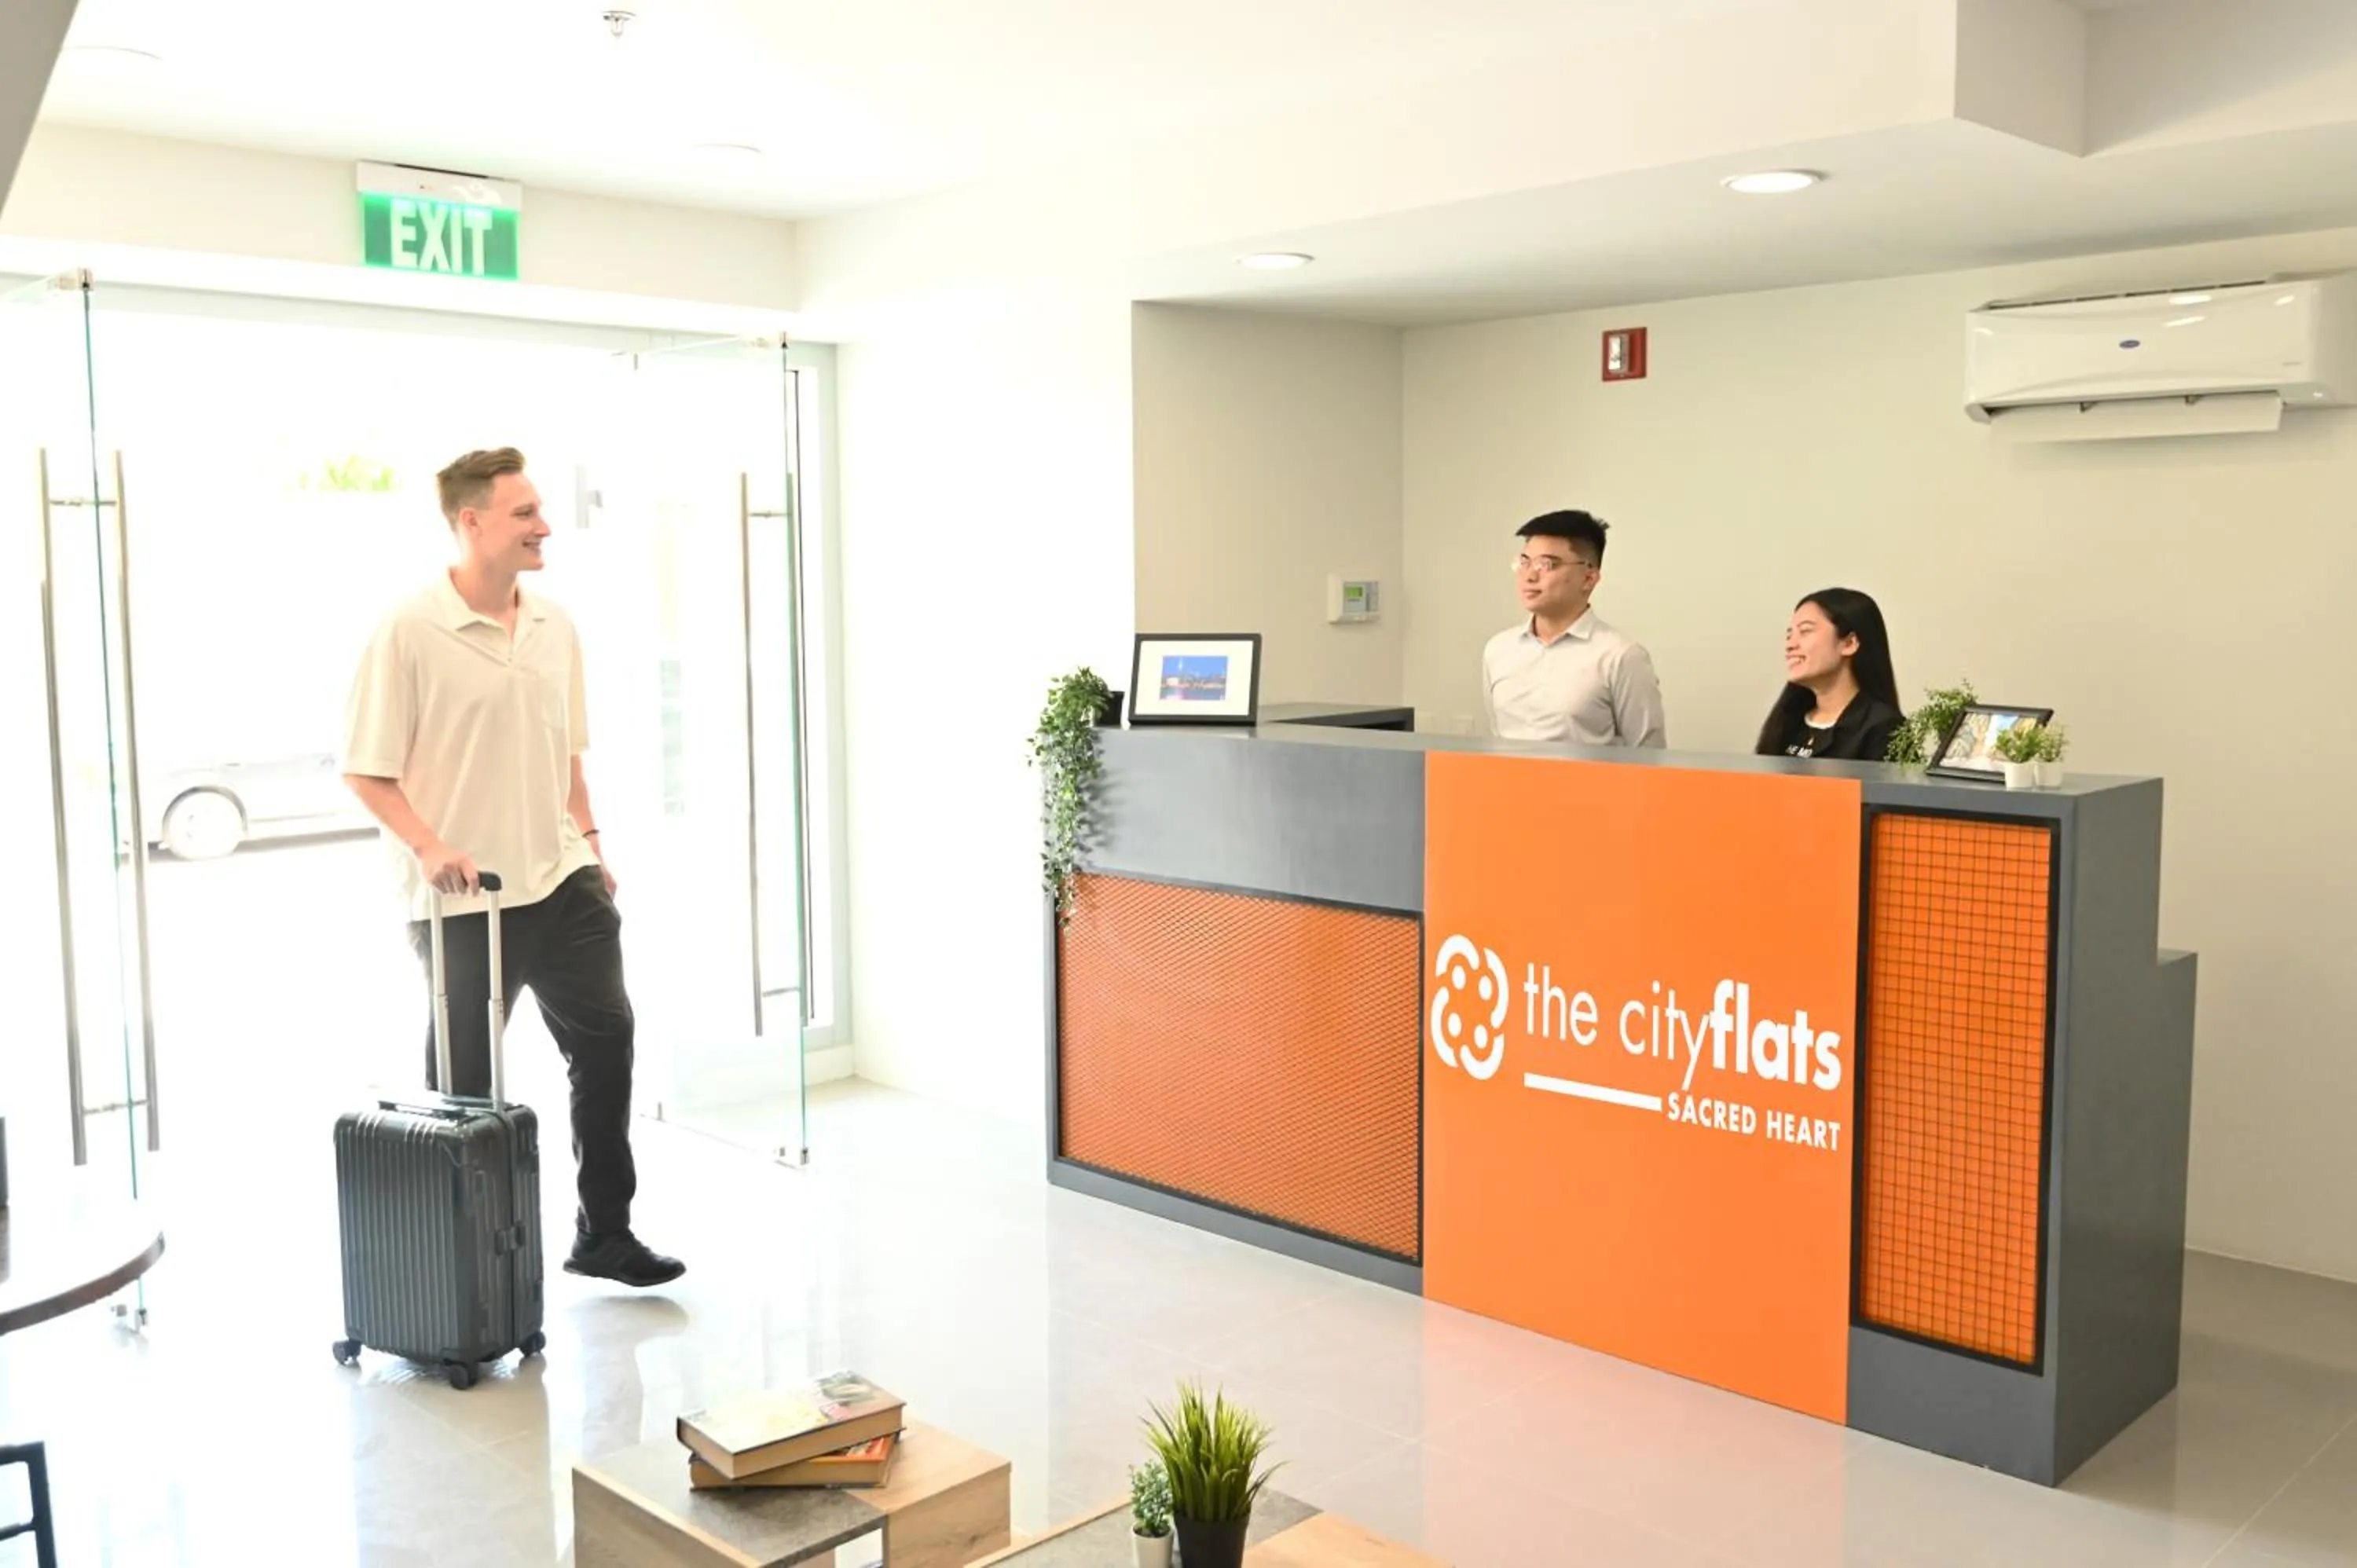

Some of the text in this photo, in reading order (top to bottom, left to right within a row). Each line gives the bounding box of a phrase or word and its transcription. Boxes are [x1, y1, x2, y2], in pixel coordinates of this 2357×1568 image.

[390, 196, 493, 277] EXIT
[1523, 962, 1842, 1091] the cityflats
[1667, 1091, 1842, 1152] SACRED HEART
